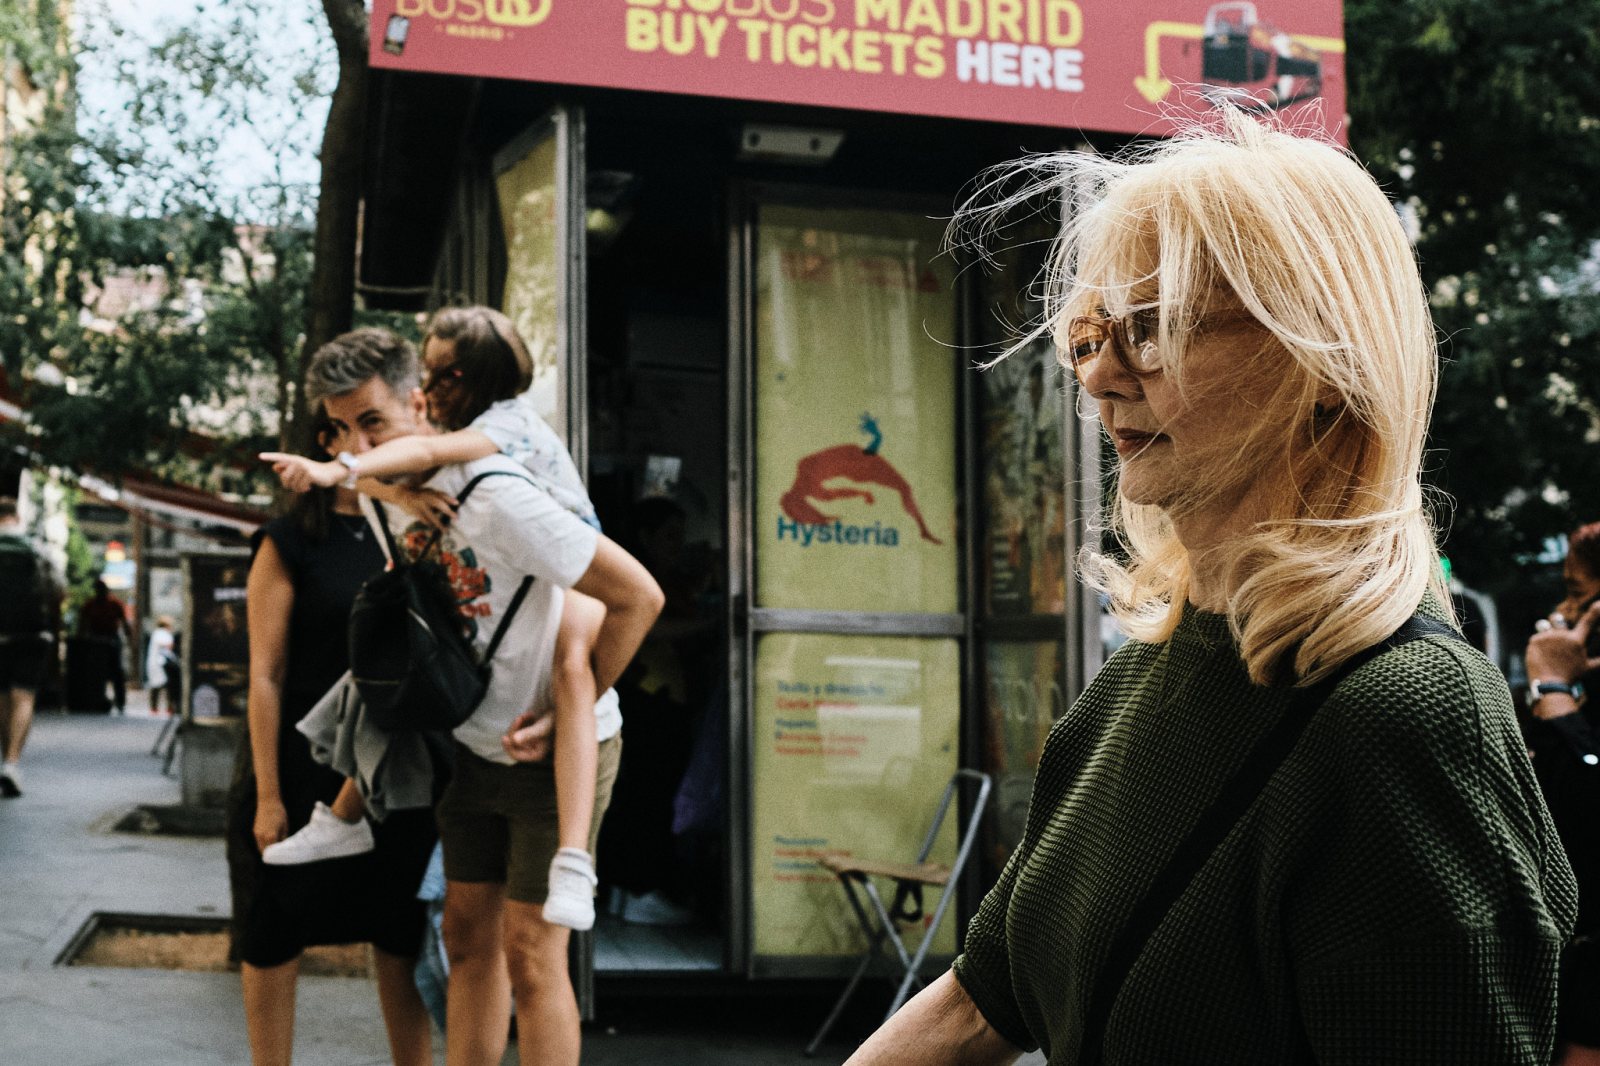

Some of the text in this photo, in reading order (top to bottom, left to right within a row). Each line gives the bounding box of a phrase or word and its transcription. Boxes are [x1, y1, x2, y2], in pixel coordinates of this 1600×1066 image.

[855, 0, 1084, 48] MADRID
[625, 7, 729, 58] BUY
[736, 17, 946, 79] TICKETS
[956, 38, 1085, 93] HERE
[777, 515, 899, 547] Hysteria
